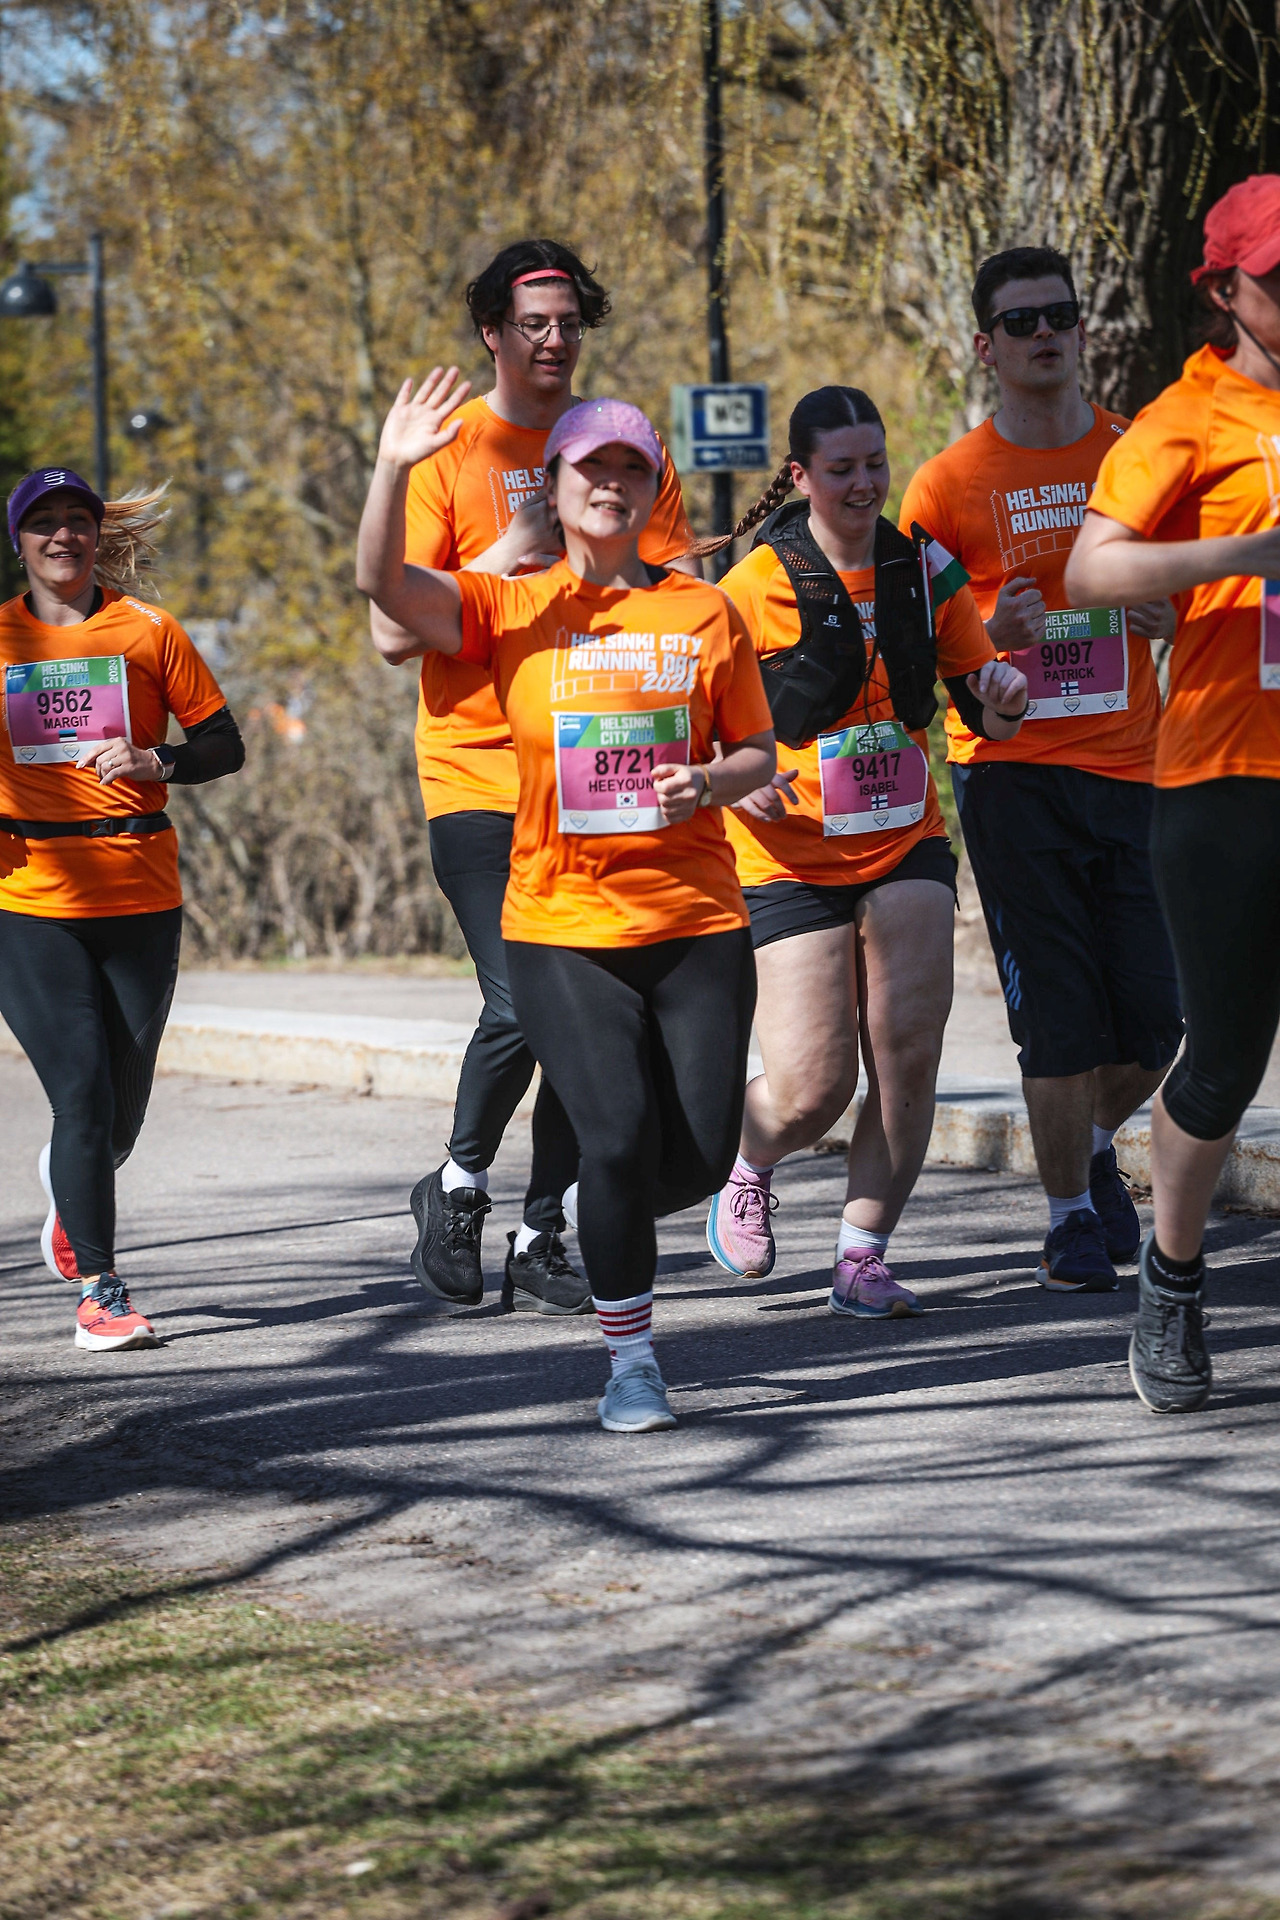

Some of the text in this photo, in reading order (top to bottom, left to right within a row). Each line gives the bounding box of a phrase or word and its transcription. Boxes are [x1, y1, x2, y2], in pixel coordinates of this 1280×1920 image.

[502, 467, 546, 490] HELS
[1045, 612, 1090, 627] HELSINKI
[1108, 608, 1119, 634] 2024
[571, 632, 704, 656] HELSINKI CITY
[1041, 640, 1094, 667] 9097
[41, 661, 89, 676] HELSINKI
[108, 659, 118, 683] 2024
[568, 651, 657, 671] RUNNING
[640, 671, 696, 696] 2024
[1044, 667, 1095, 682] PATRICK
[37, 689, 93, 715] 9562
[43, 715, 90, 730] MARGIT
[600, 715, 654, 730] HELSINKI
[674, 709, 686, 739] 2024
[594, 747, 655, 776] 8721
[852, 752, 901, 782] 9417
[860, 780, 899, 797] ISABEL
